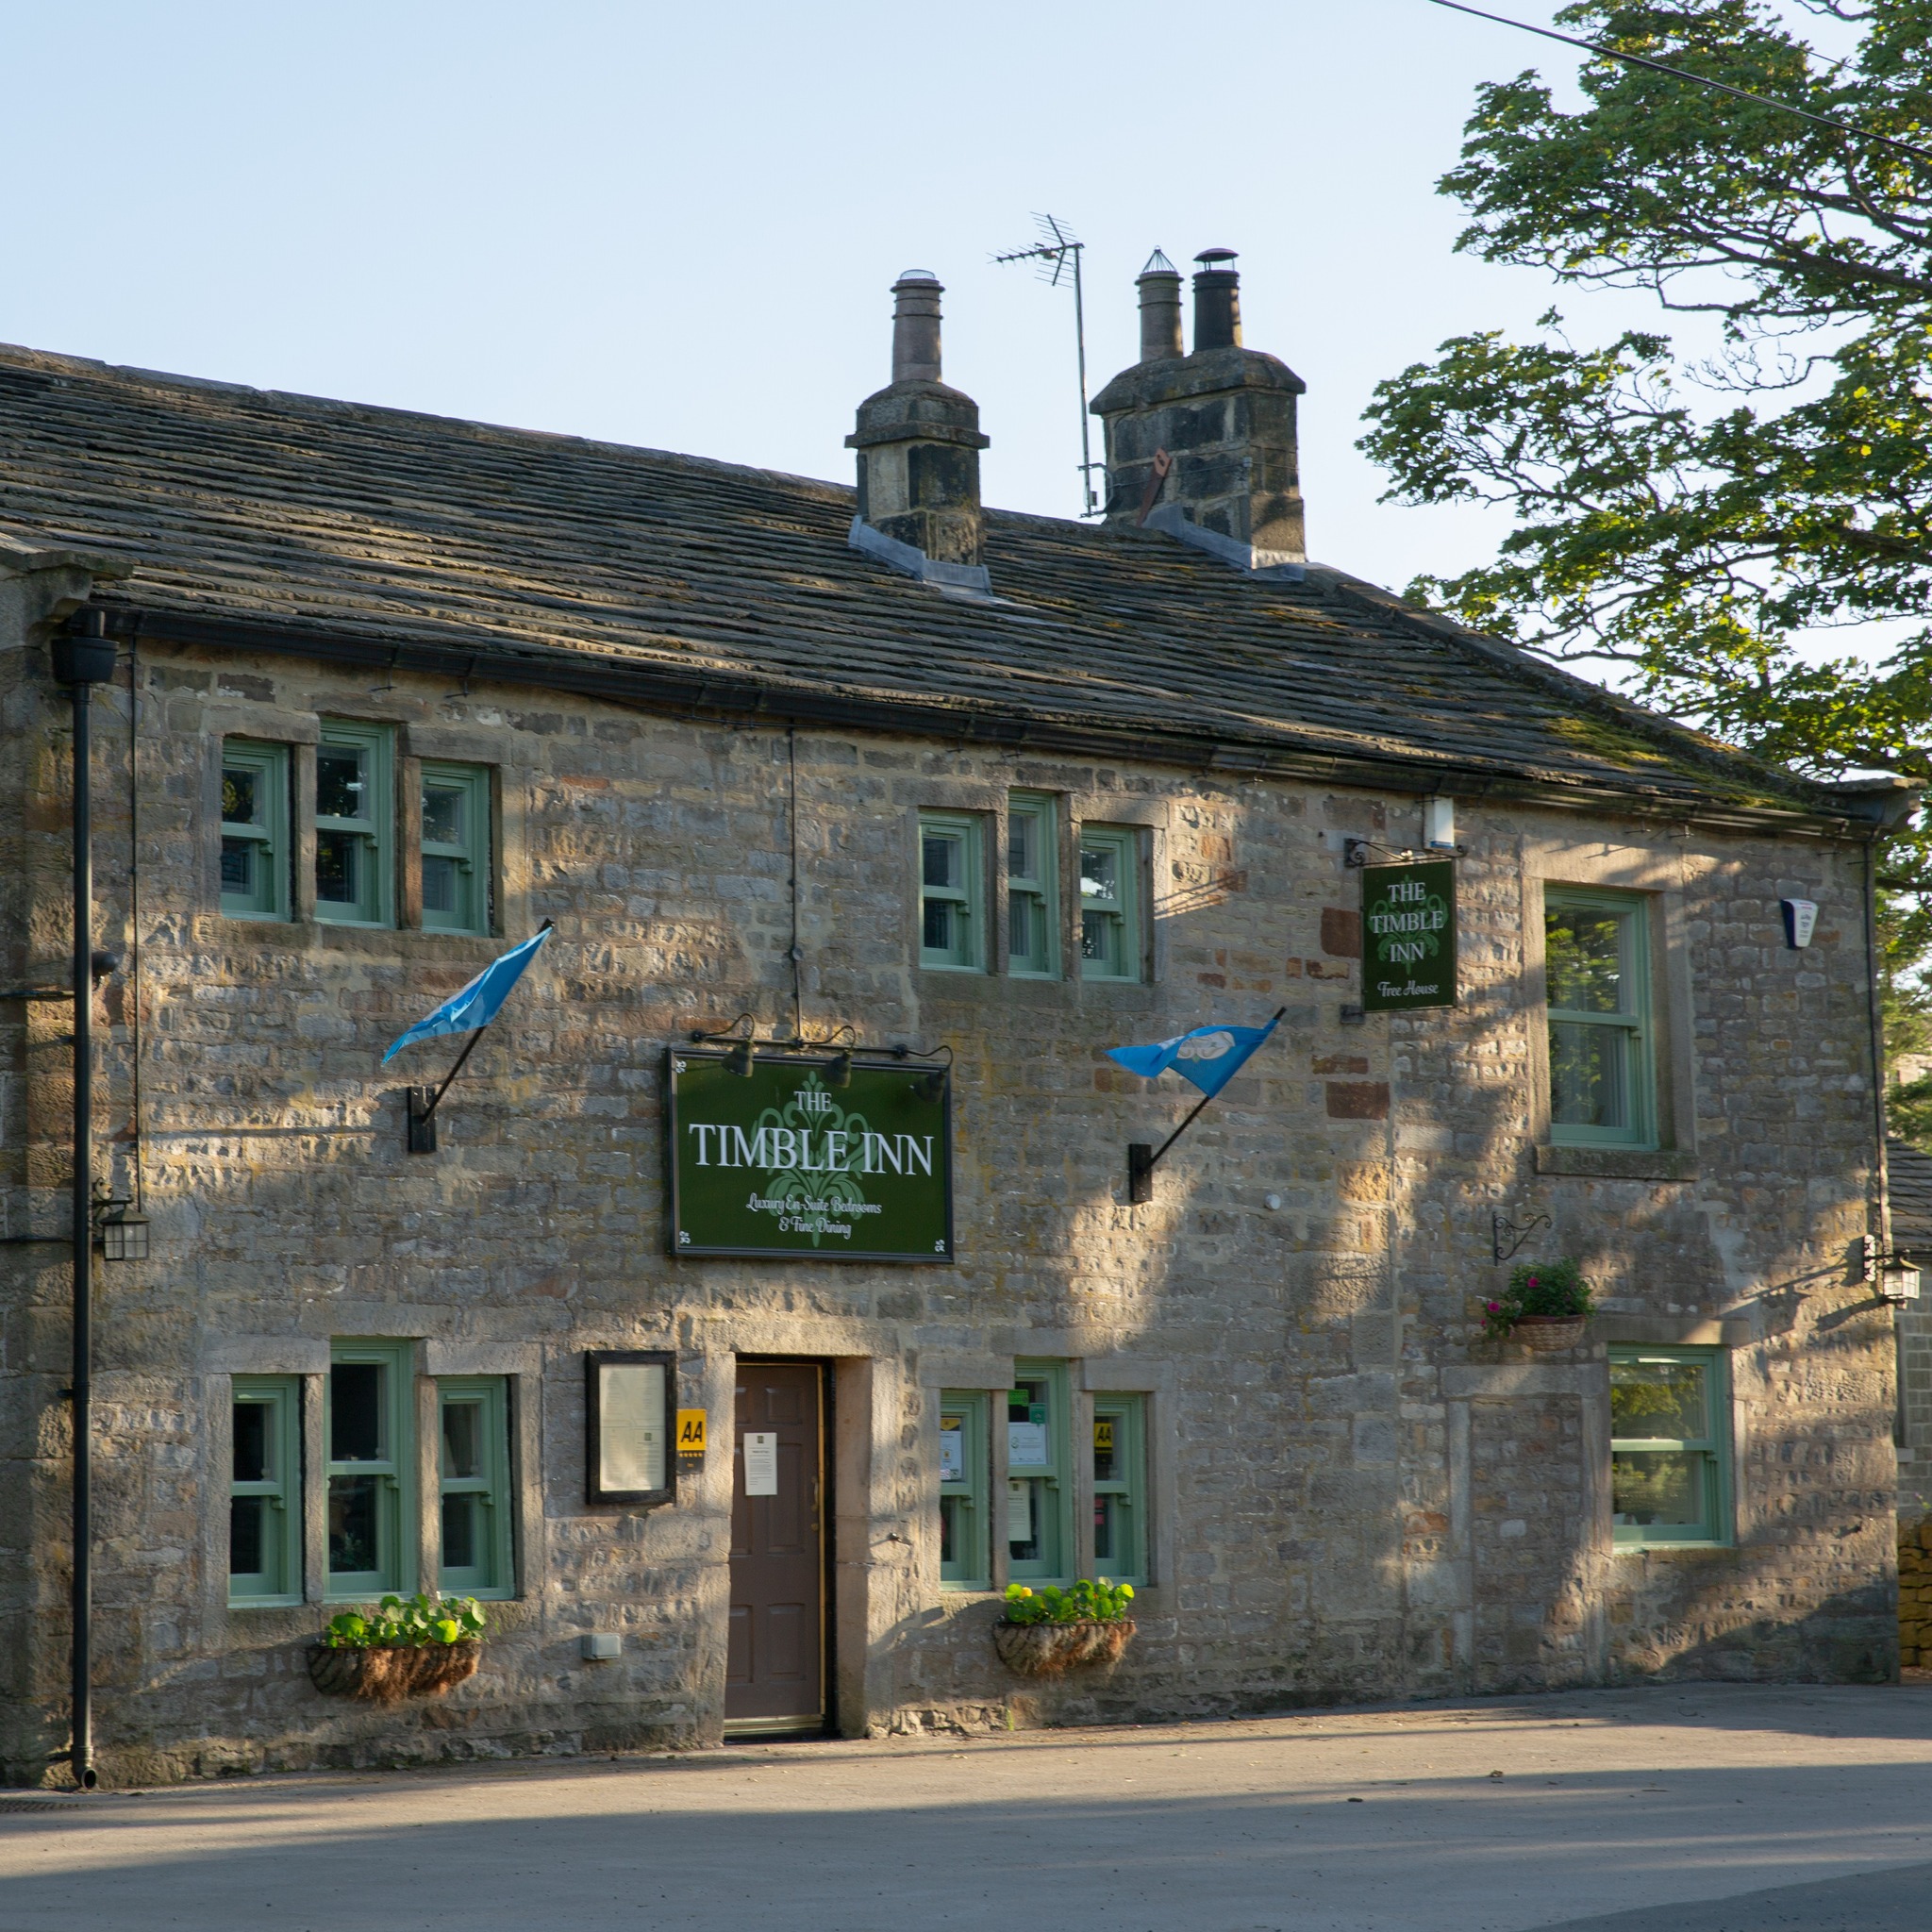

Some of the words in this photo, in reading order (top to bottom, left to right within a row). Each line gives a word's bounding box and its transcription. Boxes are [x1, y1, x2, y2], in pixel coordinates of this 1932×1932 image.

[1387, 882, 1426, 903] THE
[1371, 910, 1444, 934] TIMBLE
[1390, 942, 1425, 962] INN
[1403, 980, 1439, 996] House
[793, 1091, 833, 1112] THE
[689, 1123, 850, 1172] TIMBLE
[860, 1132, 935, 1176] INN
[745, 1192, 785, 1215] Luxury
[785, 1193, 829, 1212] En-Suite
[830, 1196, 883, 1214] Bedrooms
[778, 1216, 790, 1232] &
[790, 1216, 814, 1232] Fine
[815, 1217, 852, 1240] Dining
[680, 1421, 703, 1442] AA
[1096, 1425, 1111, 1442] AA
